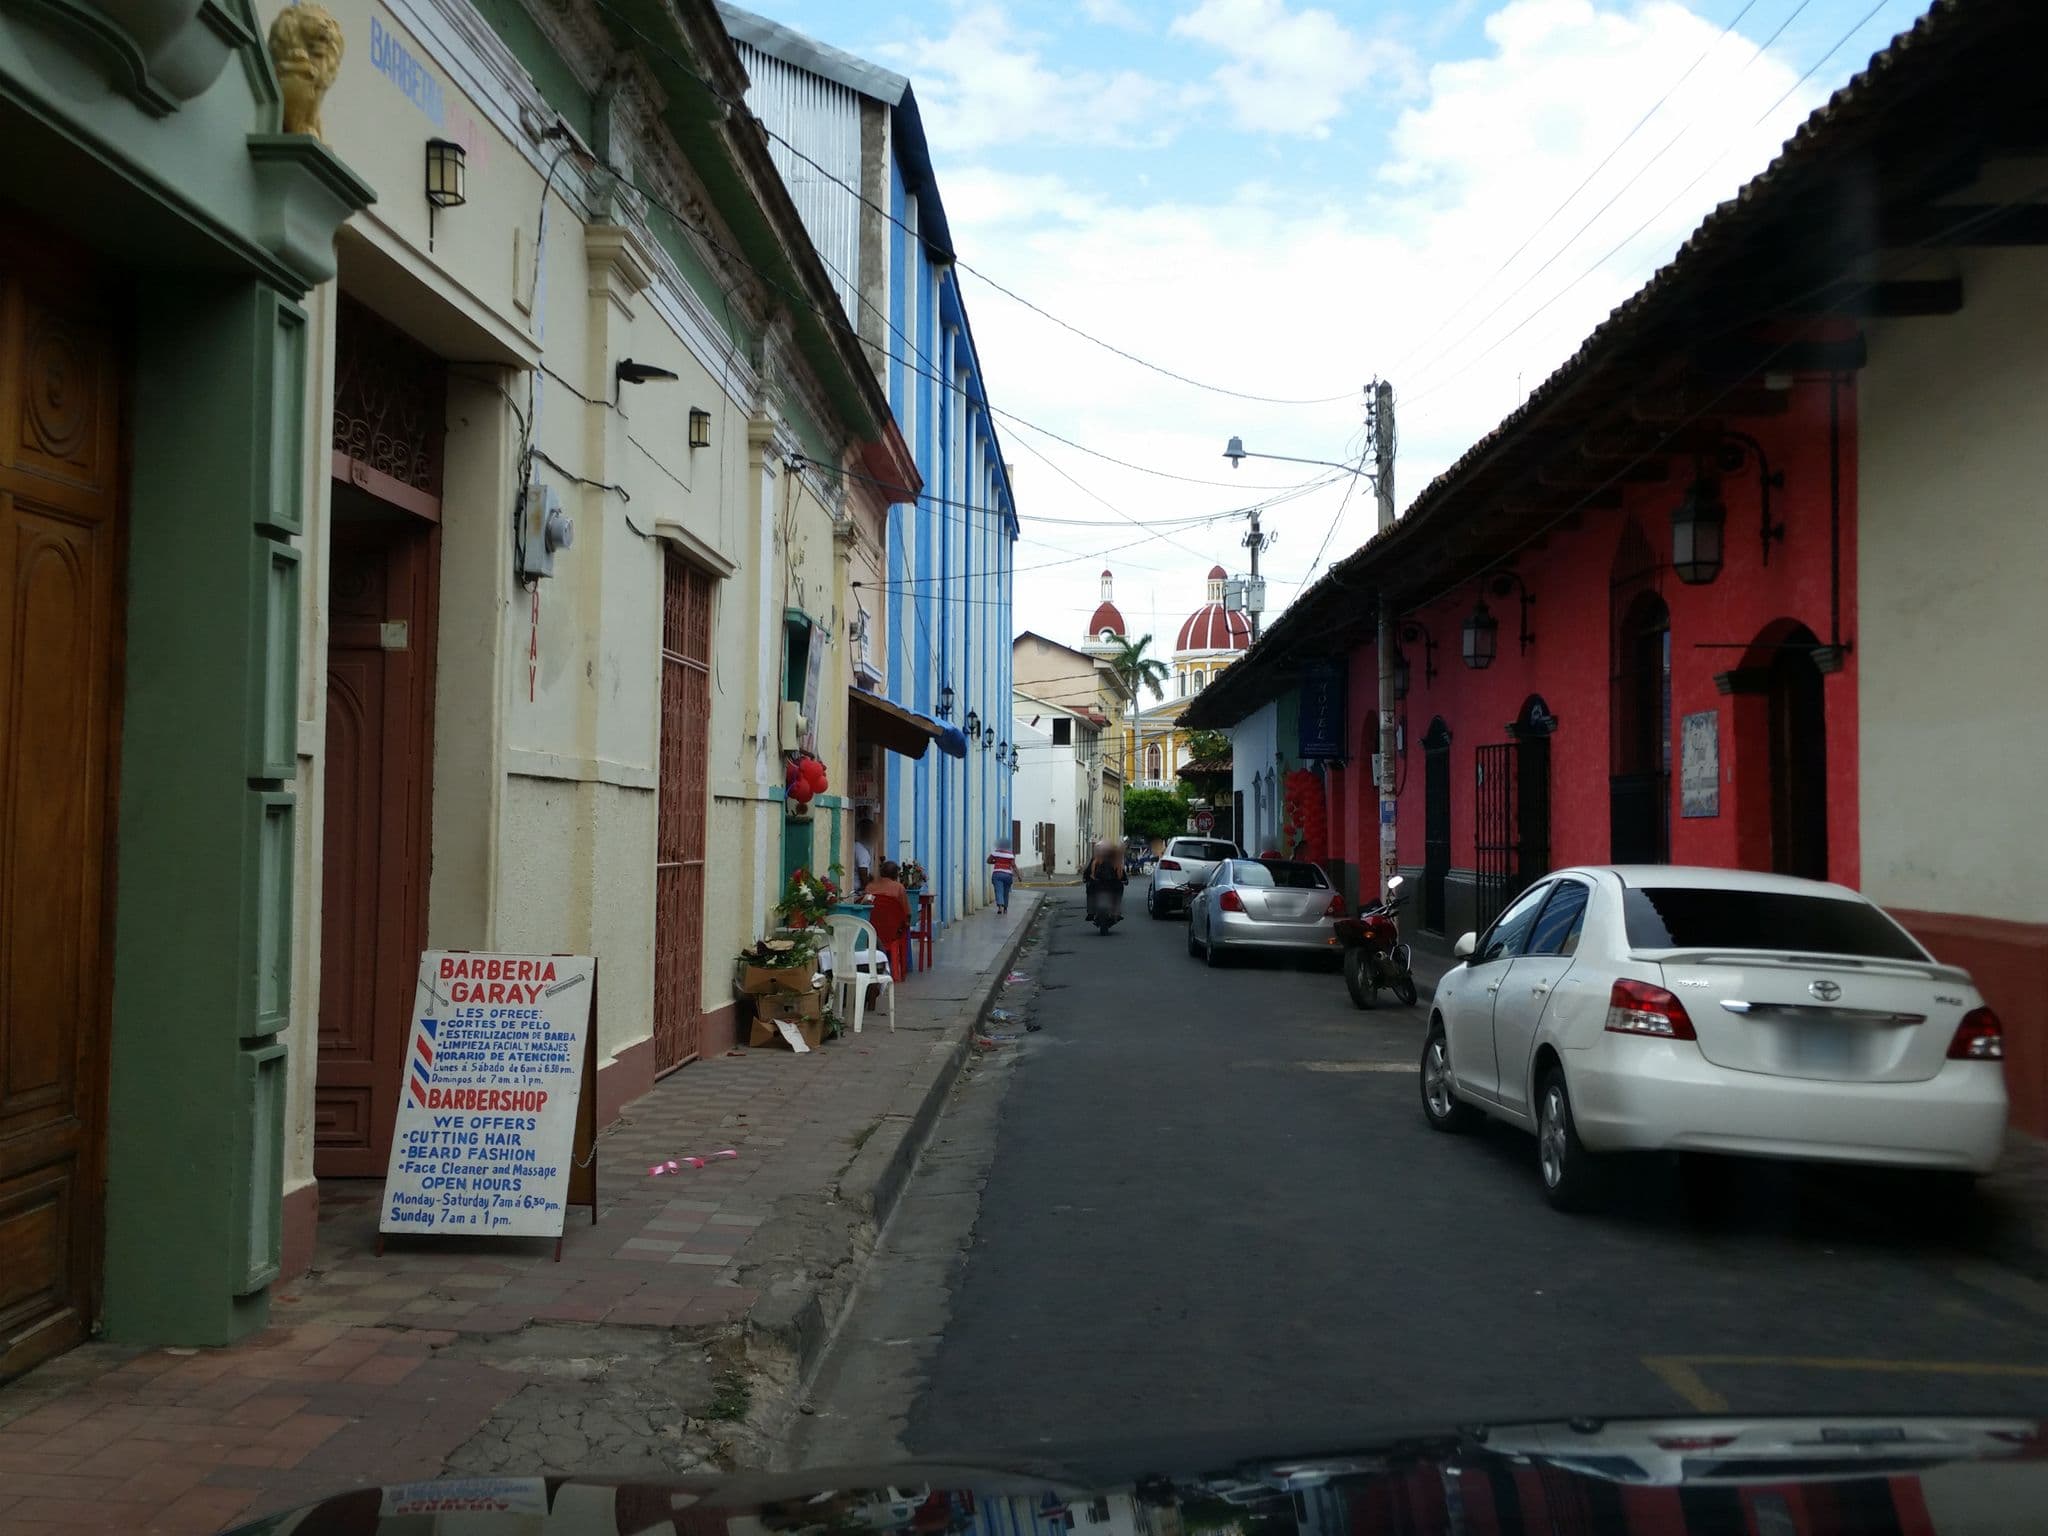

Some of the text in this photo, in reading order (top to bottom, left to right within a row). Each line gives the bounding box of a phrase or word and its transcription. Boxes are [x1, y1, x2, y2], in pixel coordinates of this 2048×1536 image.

[440, 958, 556, 981] BARBERIA
[456, 1008, 543, 1019] LES OFRECE:
[448, 1020, 550, 1030] CORTES DE PELO
[446, 1030, 576, 1041] ESTERILIZACION DE BARBA
[443, 1041, 569, 1052] LIMPIEZA FACIAL Y MASAJES
[436, 1052, 570, 1062] HORARIO DE ATENCION:
[434, 1062, 458, 1072] Lunes
[509, 1064, 518, 1073] de
[477, 1075, 486, 1083] de
[428, 1088, 548, 1113] BARBERSHOP
[434, 1116, 536, 1130] WE OFFERS
[410, 1130, 521, 1146] CUTTING HAIR
[408, 1146, 535, 1161] BEARD FASHION
[405, 1161, 556, 1180] Face Cleaner and Massage
[422, 1177, 522, 1191] OPEN HOURS
[391, 1207, 435, 1227] Sunday
[470, 1214, 476, 1224] a
